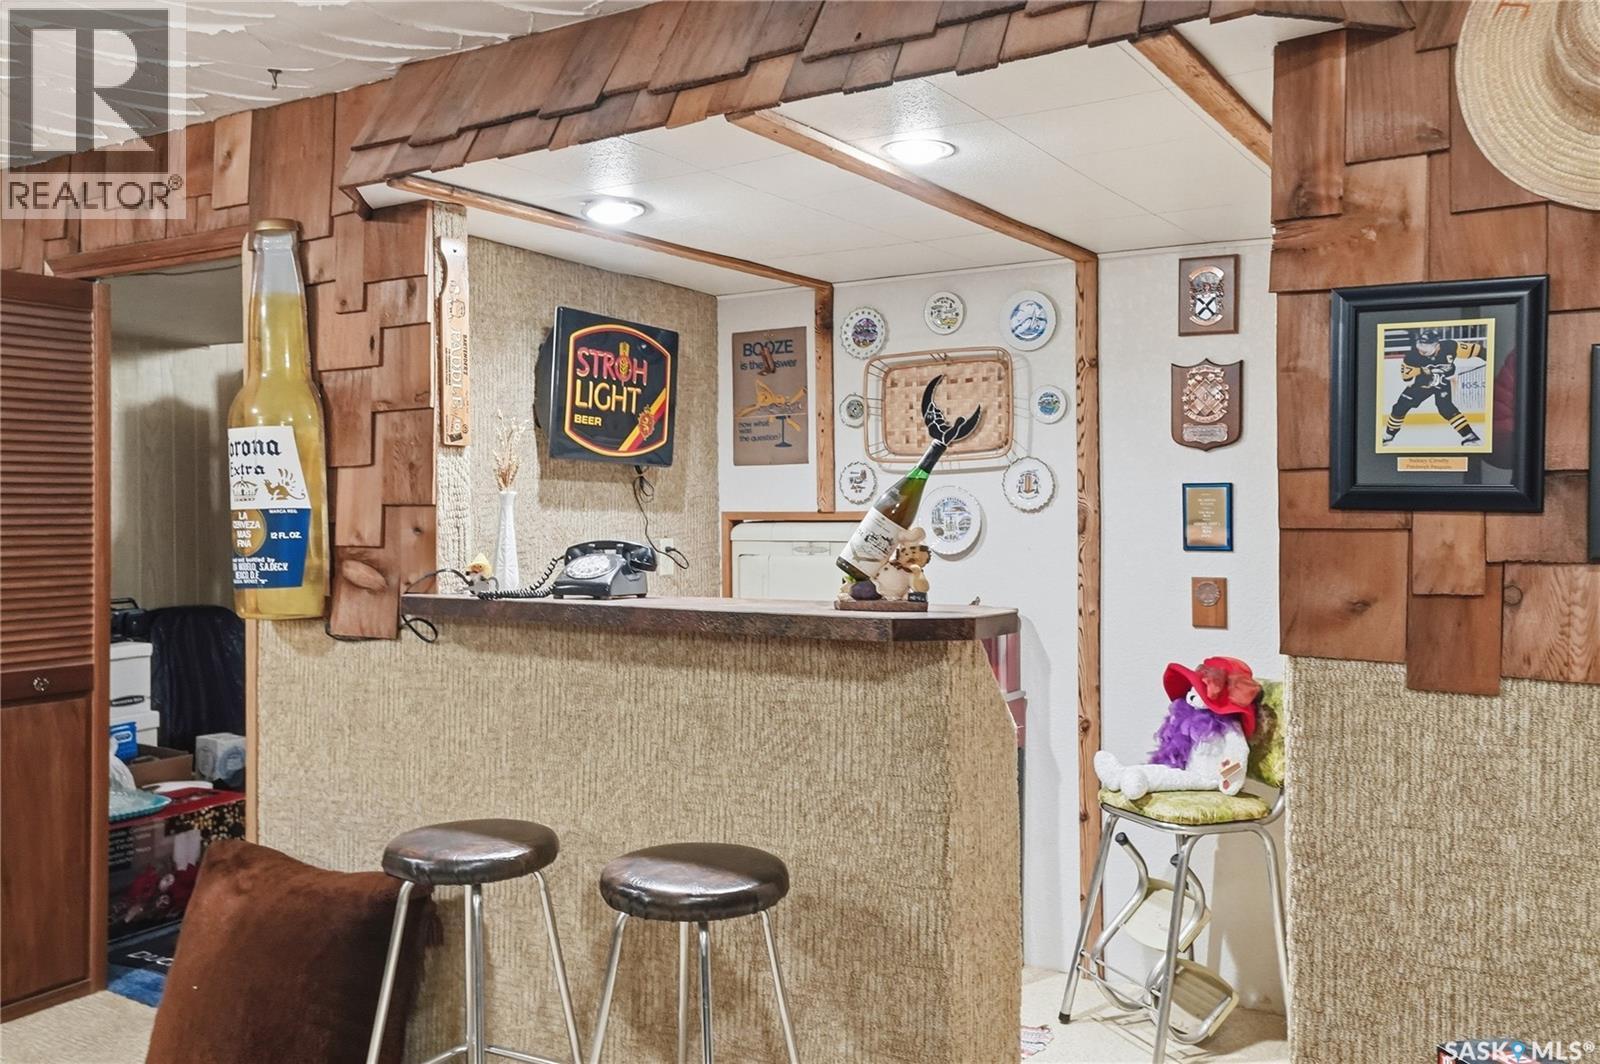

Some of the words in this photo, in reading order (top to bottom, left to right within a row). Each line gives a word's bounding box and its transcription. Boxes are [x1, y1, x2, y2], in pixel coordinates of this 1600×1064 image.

[743, 339, 794, 357] BOOZE
[576, 346, 649, 386] STROH
[749, 360, 764, 370] the
[575, 379, 642, 414] LIGHT
[574, 413, 602, 426] BEER
[229, 438, 282, 457] orona
